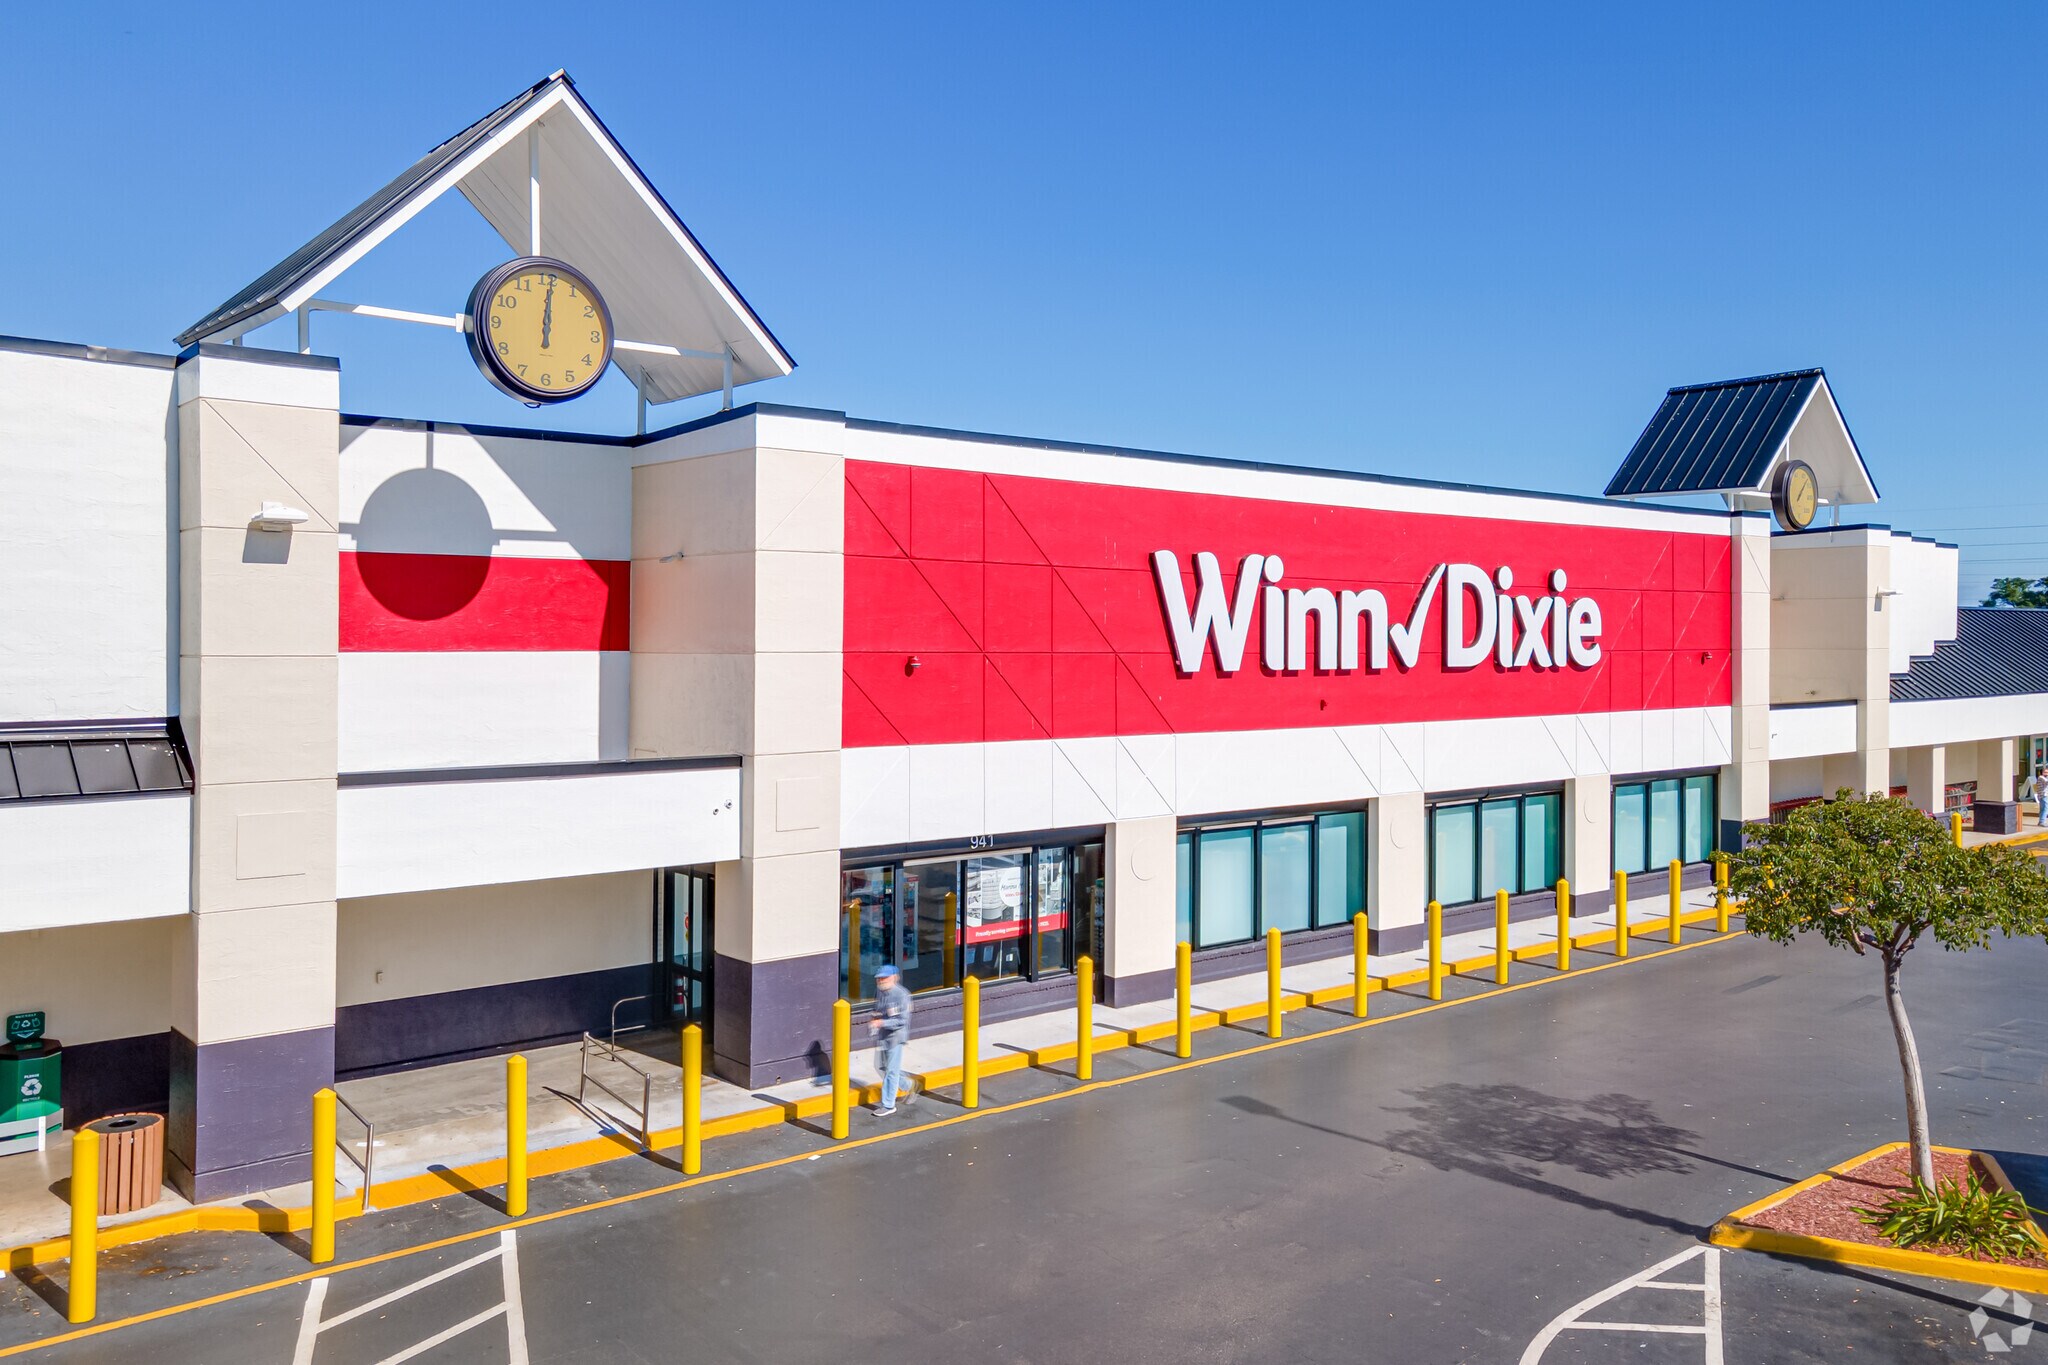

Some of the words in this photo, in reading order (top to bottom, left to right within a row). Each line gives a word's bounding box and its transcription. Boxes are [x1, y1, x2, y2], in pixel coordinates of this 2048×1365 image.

[514, 279, 532, 292] 11
[538, 273, 557, 287] 12
[569, 285, 577, 297] 1
[497, 294, 517, 308] 10
[583, 305, 594, 318] 2
[491, 316, 501, 328] 9
[590, 331, 600, 343] 3
[498, 342, 509, 355] 8
[581, 354, 592, 366] 4
[517, 364, 528, 376] 7
[540, 374, 551, 386] 6
[565, 371, 575, 382] 5
[1152, 550, 1389, 676] Winn
[1443, 563, 1602, 671] Dixie
[970, 834, 994, 850] 941
